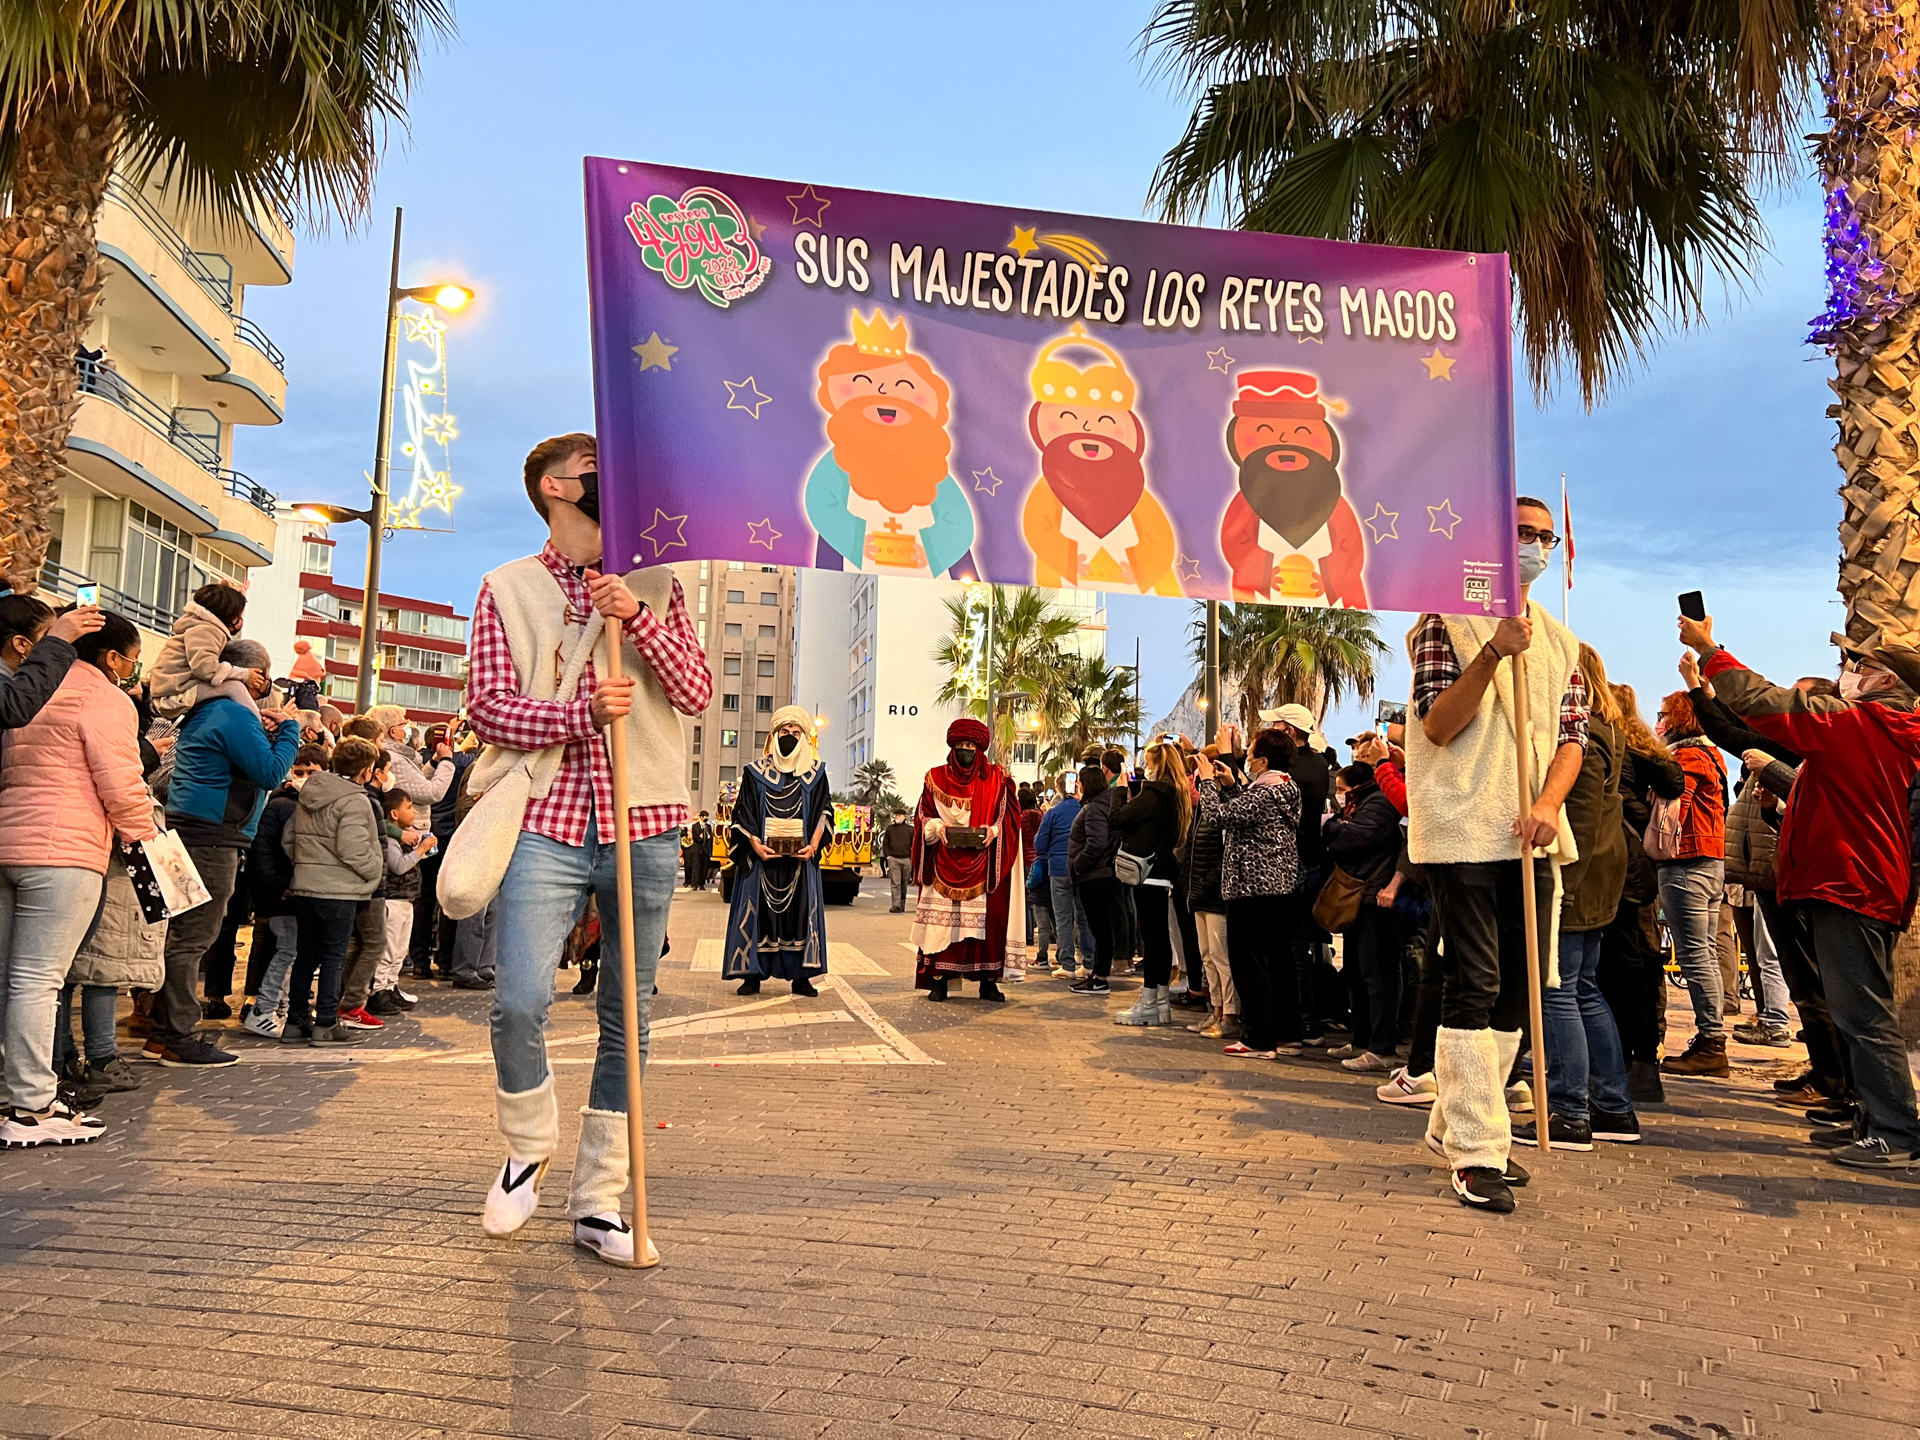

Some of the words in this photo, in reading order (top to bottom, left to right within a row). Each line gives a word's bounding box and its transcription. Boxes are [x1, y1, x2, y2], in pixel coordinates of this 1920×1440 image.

[703, 257, 740, 274] 2022
[715, 271, 744, 286] CALP
[794, 231, 870, 292] SUS
[890, 242, 1129, 323] MAJESTADES
[1143, 269, 1206, 329] LOS
[1220, 276, 1324, 334] REYES
[1340, 286, 1457, 341] MAGOS
[888, 704, 918, 717] RIO
